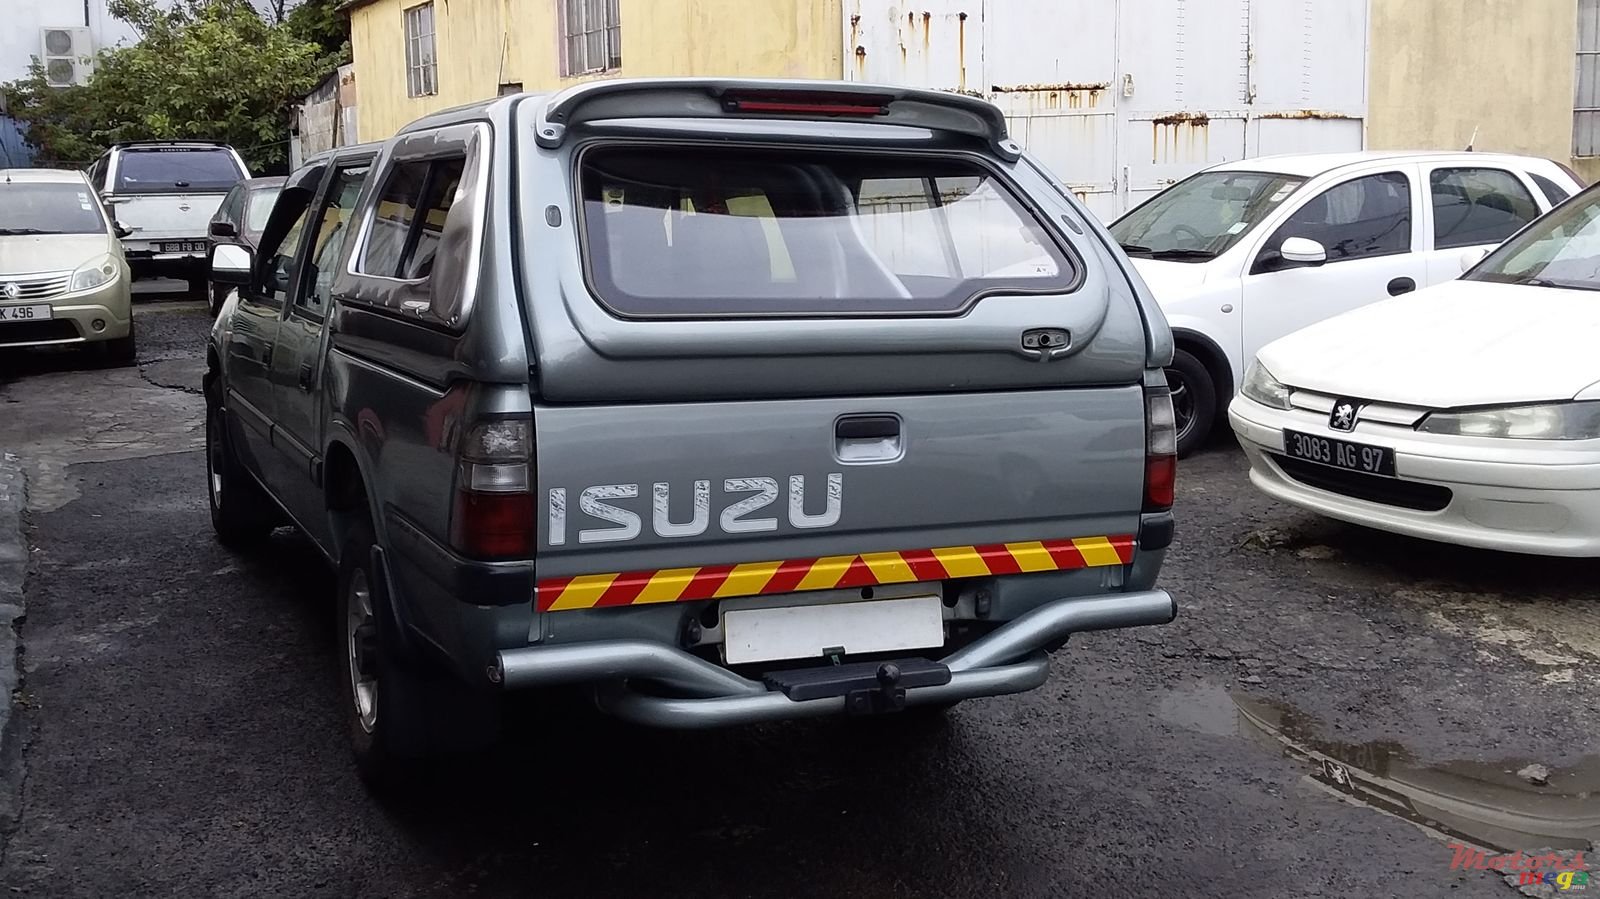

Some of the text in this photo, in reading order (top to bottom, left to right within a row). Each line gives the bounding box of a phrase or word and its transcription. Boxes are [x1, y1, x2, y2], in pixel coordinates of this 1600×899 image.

[11, 307, 34, 319] 496
[1293, 433, 1383, 472] 3083 AG 97
[548, 473, 843, 546] ISUZU
